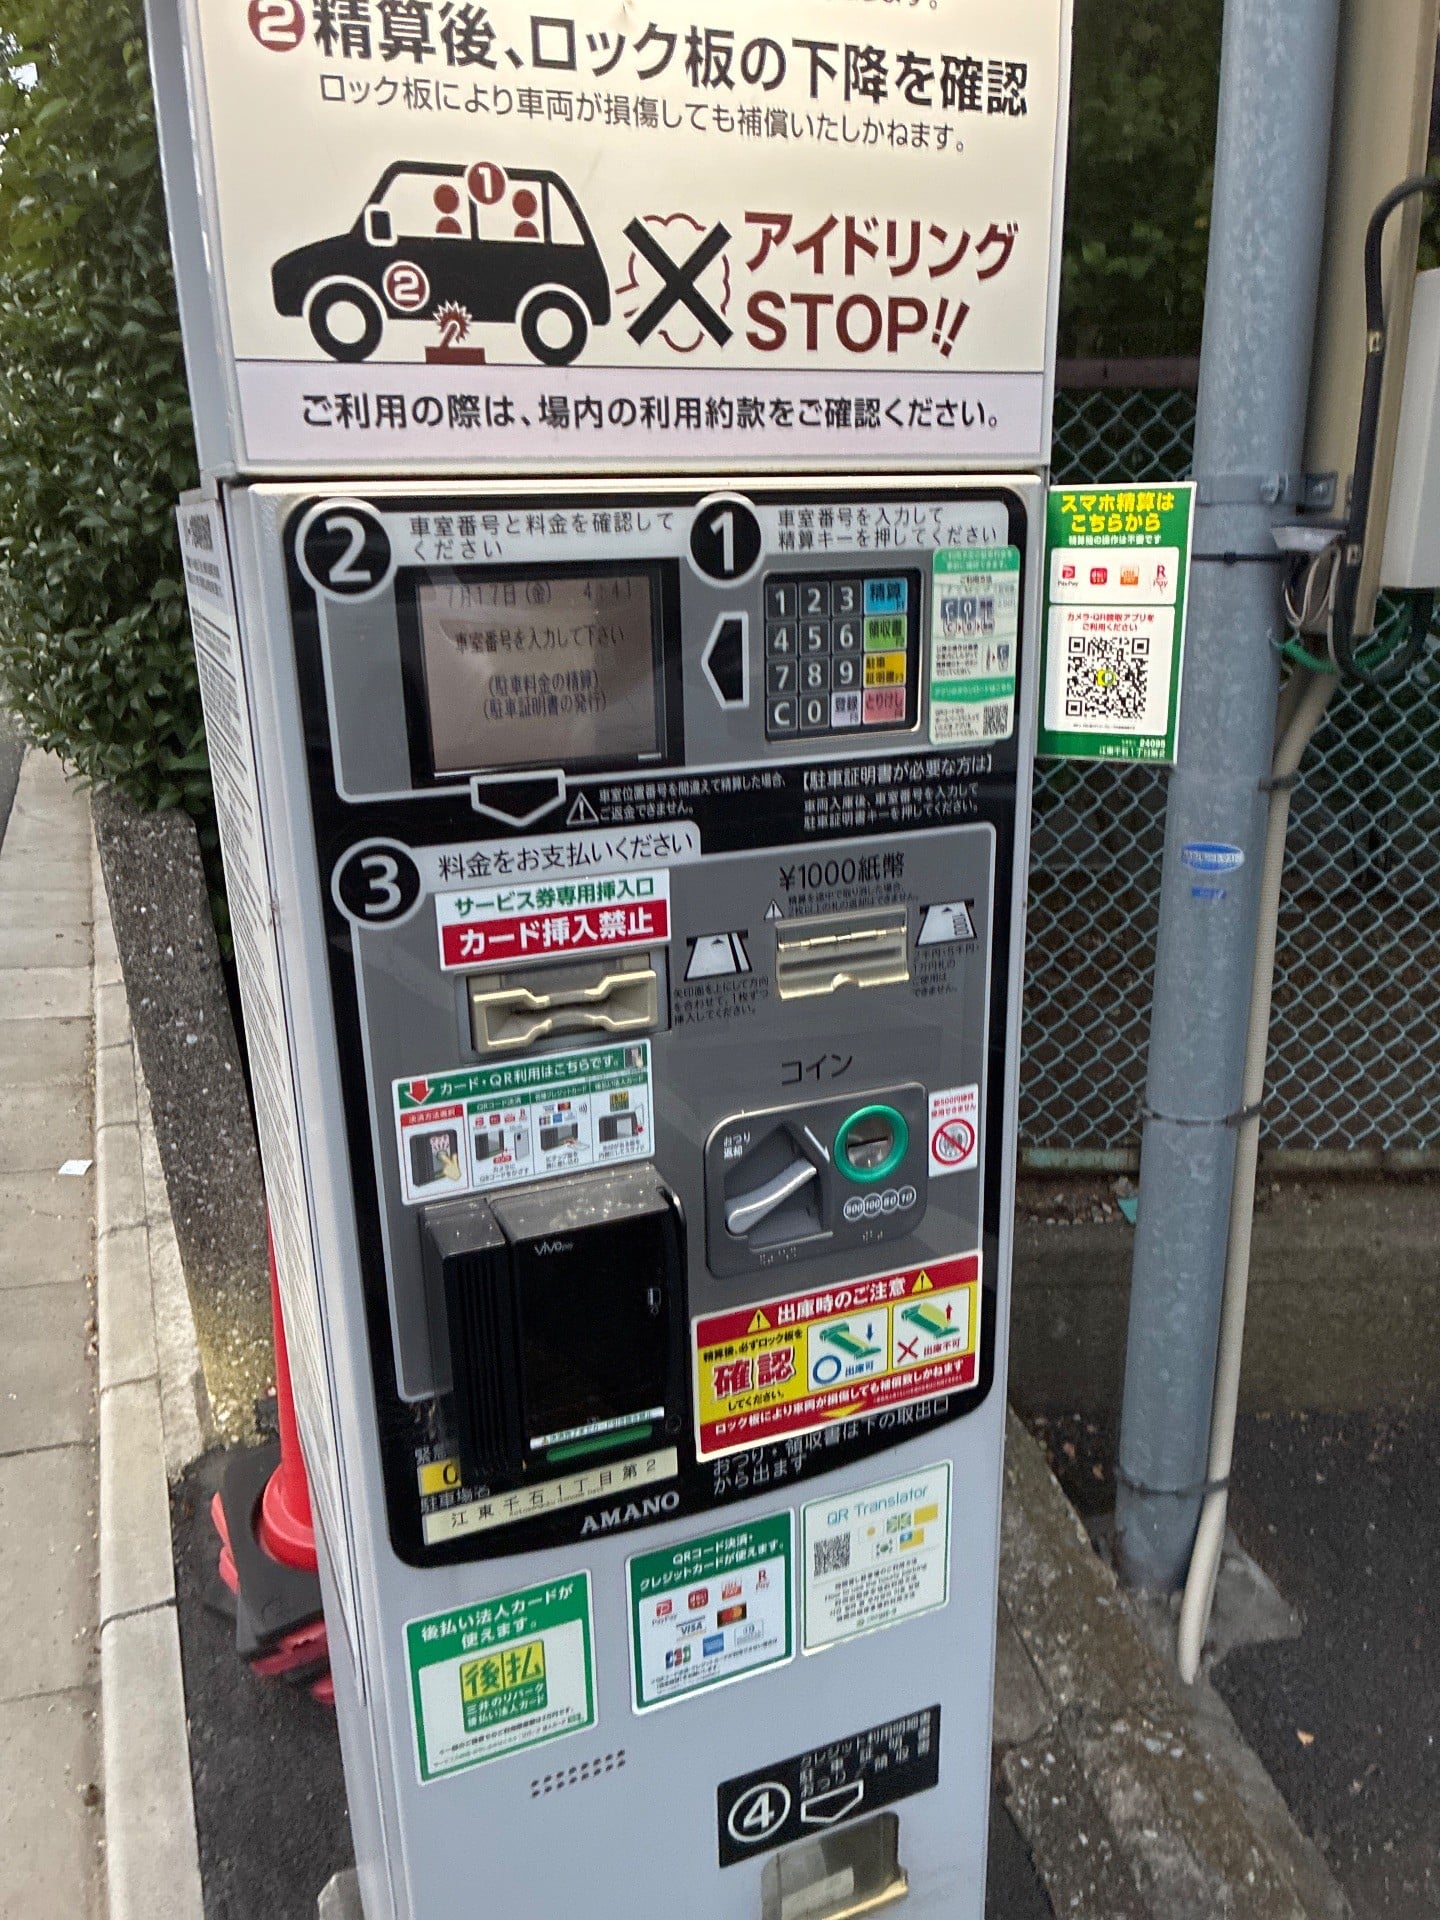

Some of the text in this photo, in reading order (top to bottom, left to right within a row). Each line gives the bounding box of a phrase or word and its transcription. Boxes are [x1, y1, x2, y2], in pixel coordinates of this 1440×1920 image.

[312, 0, 1029, 116] 精算後、ロック板の下降を確認
[320, 74, 964, 153] ロック板により車両が損傷しても補償いたしかねます。
[744, 211, 1018, 281] アイドリング
[745, 292, 969, 356] STOP!!
[301, 391, 999, 432] ご利用の際は、場内の利用約款をご確認ください。
[778, 506, 944, 528] 車室番号を入力して
[1061, 492, 1175, 513] スマホ精算は
[410, 510, 674, 537] 車室番号と料金を確認して
[778, 526, 997, 551] 精算キーを押してください
[1071, 512, 1161, 533] こちらから
[325, 515, 371, 583] 2
[414, 539, 503, 561] ください
[709, 510, 734, 572] 1
[774, 590, 786, 616] 1
[807, 588, 821, 612] 2
[840, 586, 853, 610] 3
[774, 627, 789, 652] 4
[808, 626, 821, 650] 5
[839, 624, 852, 648] 6
[1082, 622, 1138, 632] ご利用ください
[774, 665, 789, 690] 7
[807, 663, 821, 686] 8
[839, 660, 852, 684] 9
[774, 701, 790, 726] C
[808, 699, 821, 723] 0
[803, 753, 993, 792] 【駐車証明書が必要な方は】
[439, 832, 694, 882] 料金をお支払いください
[360, 855, 401, 914] 3
[455, 876, 655, 917] サービス券専用挿入口
[459, 906, 655, 957] カード挿入禁止
[440, 1054, 620, 1097] カード・QR利用はこちらです。
[781, 1054, 853, 1086] コイン
[723, 1131, 751, 1148] おつり
[777, 1277, 906, 1326] 出庫時のご注意
[923, 1338, 961, 1357] 出庫不可
[713, 1347, 797, 1399] 確認
[845, 1360, 875, 1378] 出庫可
[727, 1389, 785, 1412] してください。
[713, 1395, 950, 1477] おつり・領収書は下の取出口
[713, 1452, 808, 1496] から出ます
[580, 1490, 680, 1535] AMANO
[827, 1485, 929, 1526] QR Translator
[639, 1539, 784, 1593] クレジットカードが使えます。
[421, 1582, 574, 1643] 後払い法人カードが
[680, 1622, 704, 1636] VISA
[461, 1616, 537, 1651] 使えます。
[464, 1644, 543, 1699] 後払
[465, 1683, 544, 1716] 三井のリパーク
[466, 1695, 545, 1728] 後払い法人カード
[743, 1791, 775, 1829] 4
